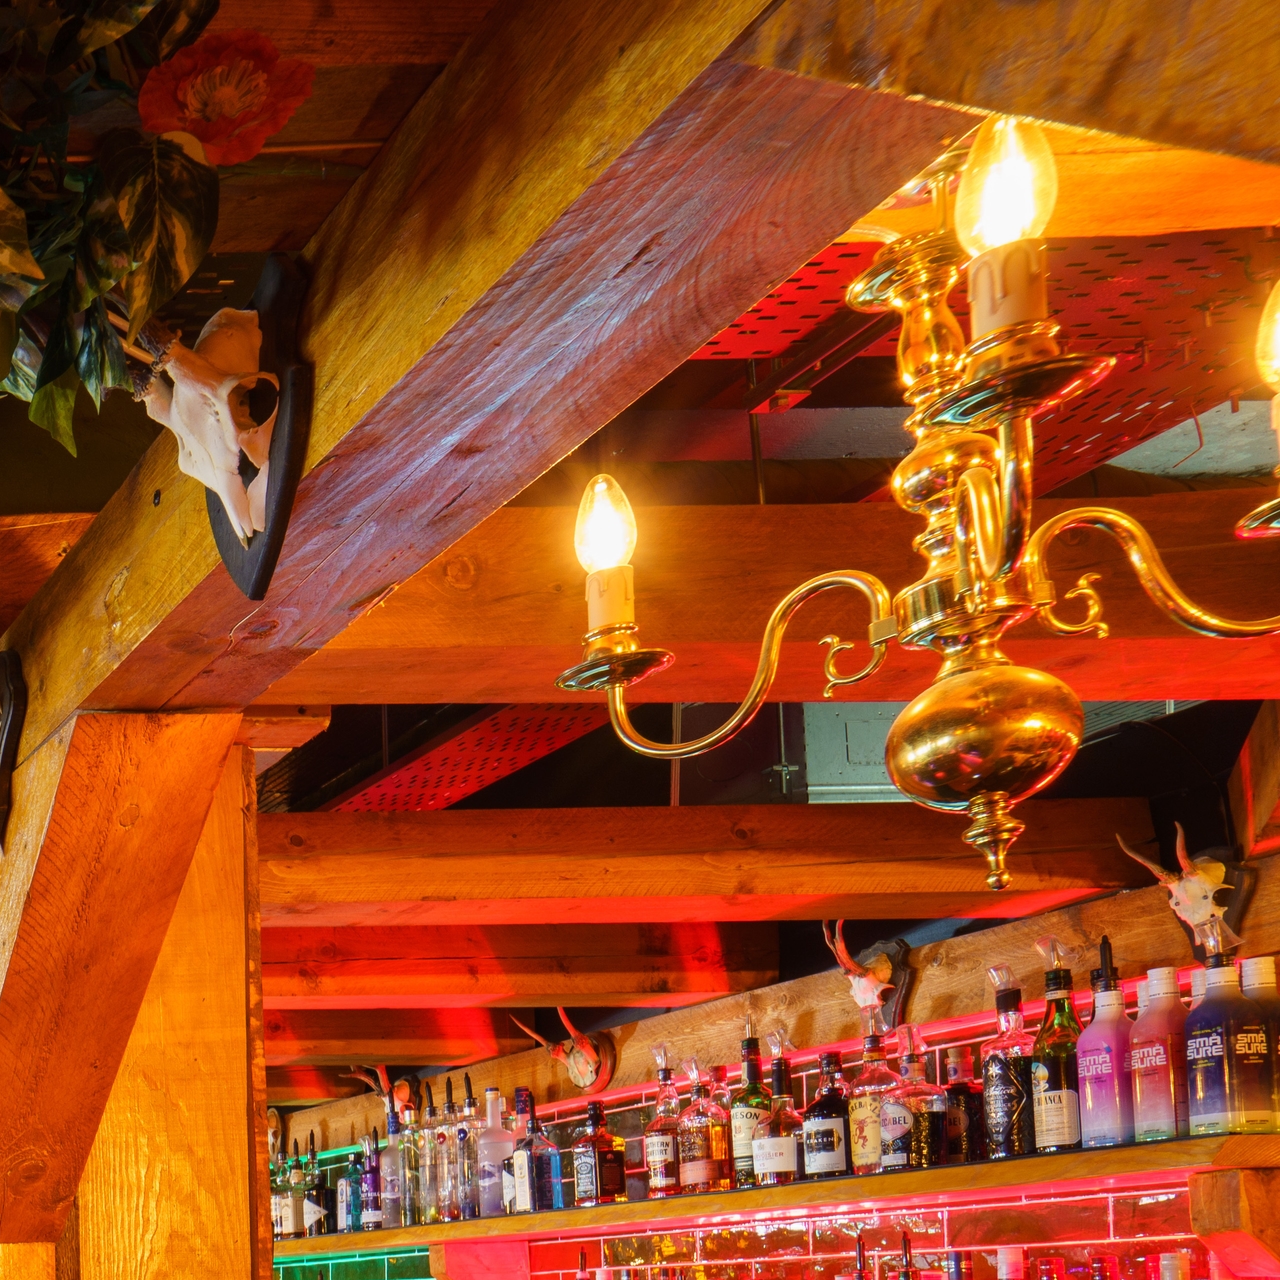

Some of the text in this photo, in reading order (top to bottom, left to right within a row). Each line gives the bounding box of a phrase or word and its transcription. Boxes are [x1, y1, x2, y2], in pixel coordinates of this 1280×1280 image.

[1187, 1032, 1221, 1049] SMÅ
[1237, 1030, 1266, 1043] SMÅ
[1131, 1043, 1164, 1059] SMÅ
[1187, 1044, 1224, 1060] SURE
[1236, 1043, 1268, 1055] SURE
[1078, 1051, 1110, 1067] SMÅ
[1131, 1054, 1167, 1070] SURE
[1078, 1063, 1112, 1077] SURE
